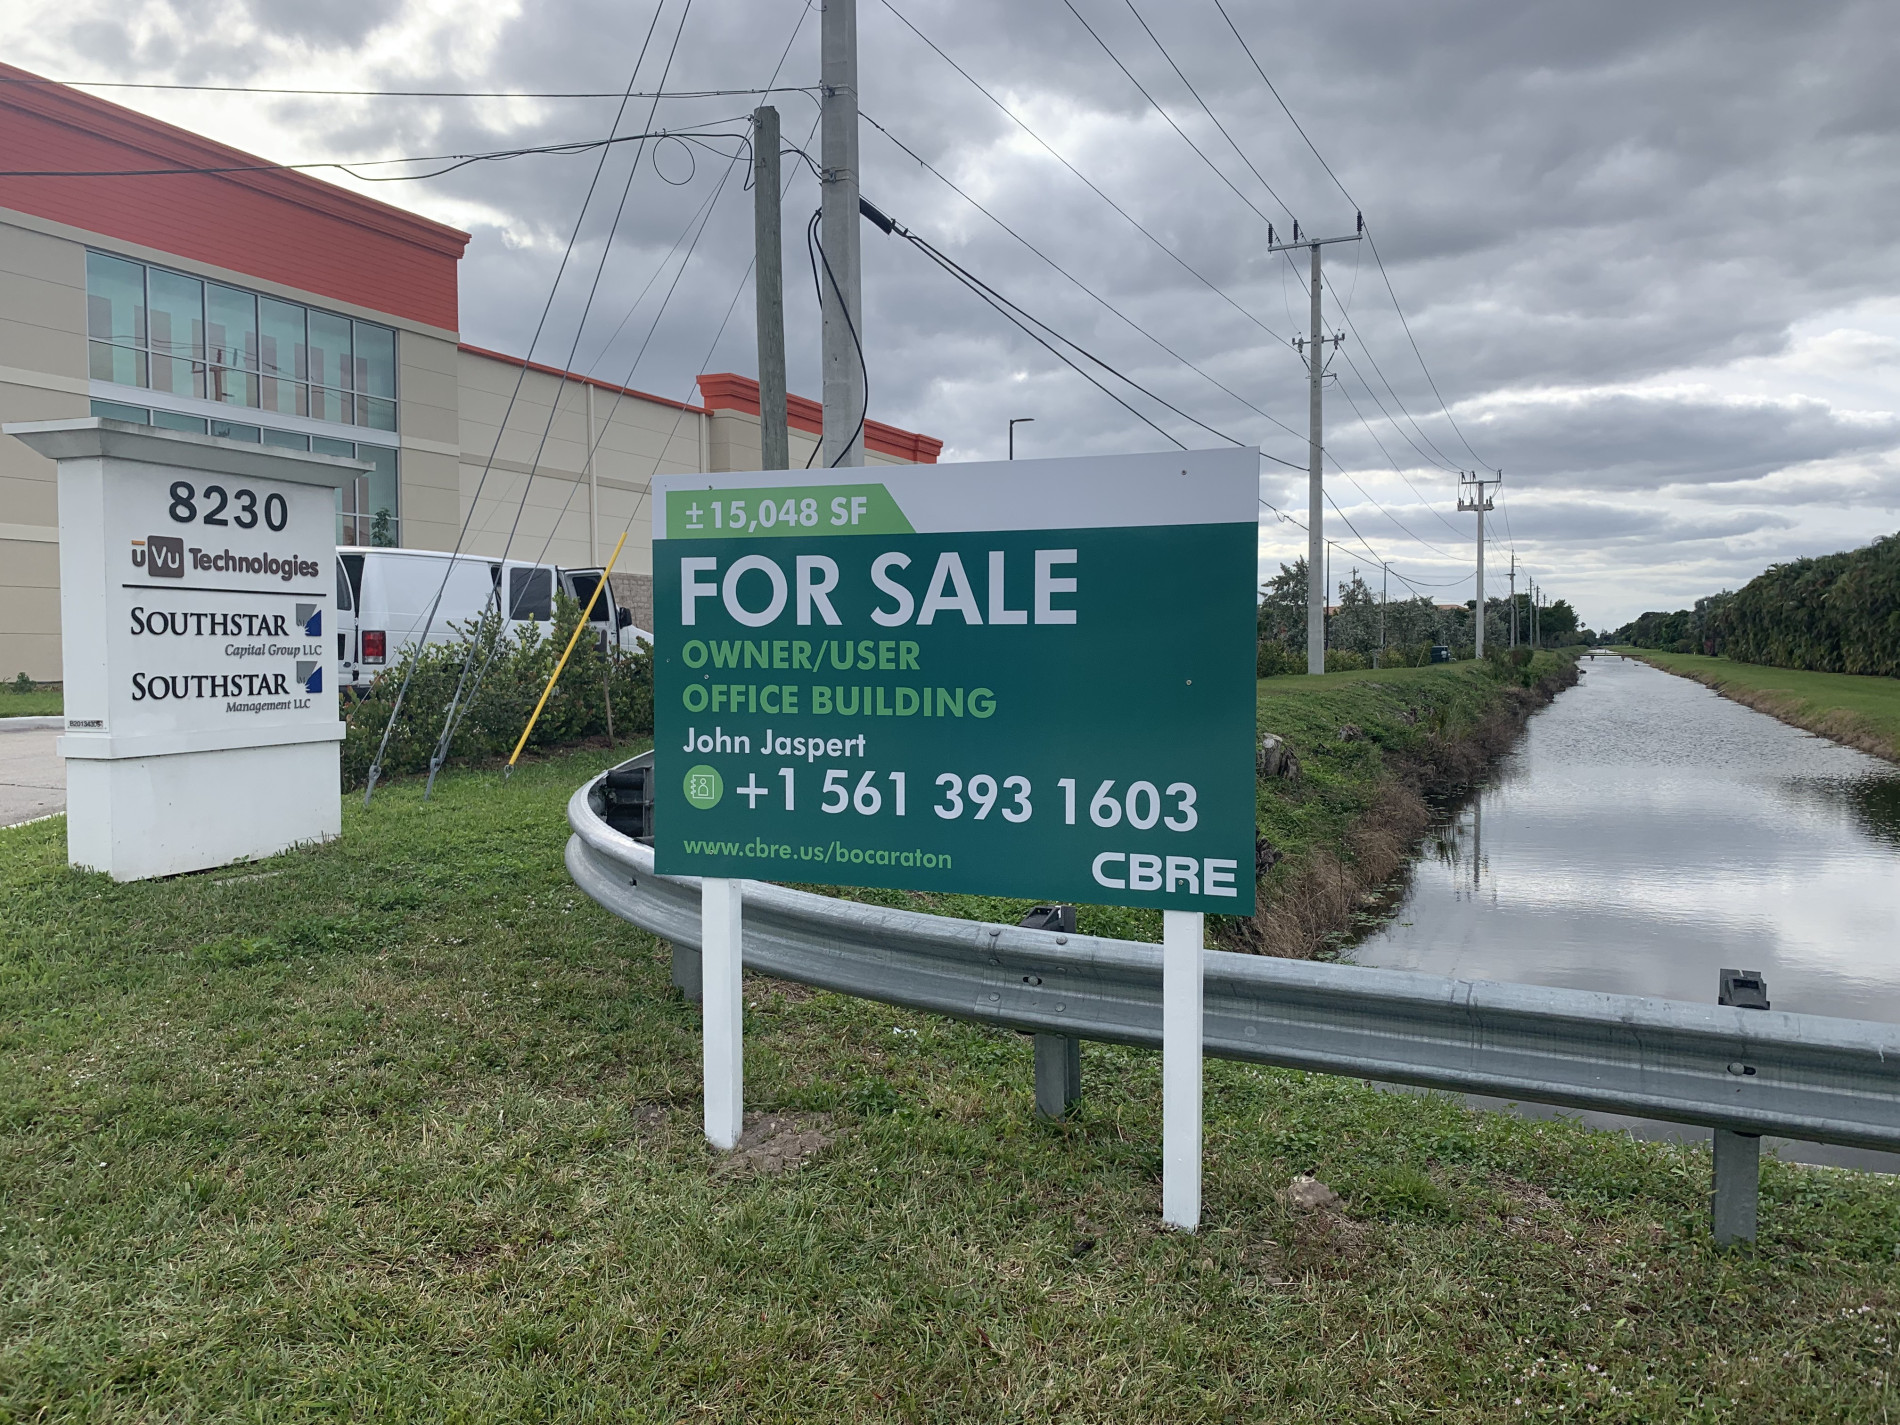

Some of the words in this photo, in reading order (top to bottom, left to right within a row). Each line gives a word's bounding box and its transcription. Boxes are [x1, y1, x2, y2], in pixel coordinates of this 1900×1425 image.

[168, 480, 288, 532] 8230
[685, 498, 818, 533] ±15,048
[830, 496, 868, 527] SF
[188, 548, 319, 581] Technologies
[680, 554, 843, 627] FOR
[869, 548, 1078, 628] SALE
[130, 606, 290, 637] SOUTHSTAR
[224, 643, 266, 658] Capital
[268, 644, 301, 660] Group
[303, 644, 323, 656] LLC
[682, 639, 921, 674] OWNER/USER
[131, 671, 291, 701] SOUTHSTAR
[682, 684, 799, 715] OFFICE
[811, 685, 997, 719] BUILDING
[225, 699, 292, 715] Management
[293, 698, 311, 710] LLC
[683, 726, 750, 755] John
[760, 729, 867, 764] Jaspert
[736, 768, 795, 811] +1
[821, 770, 907, 817] 561
[934, 773, 1033, 824] 393
[1056, 778, 1199, 832] 1603
[683, 836, 953, 870] www.cbre.us/bocaraton
[1091, 850, 1239, 898] CBRE
